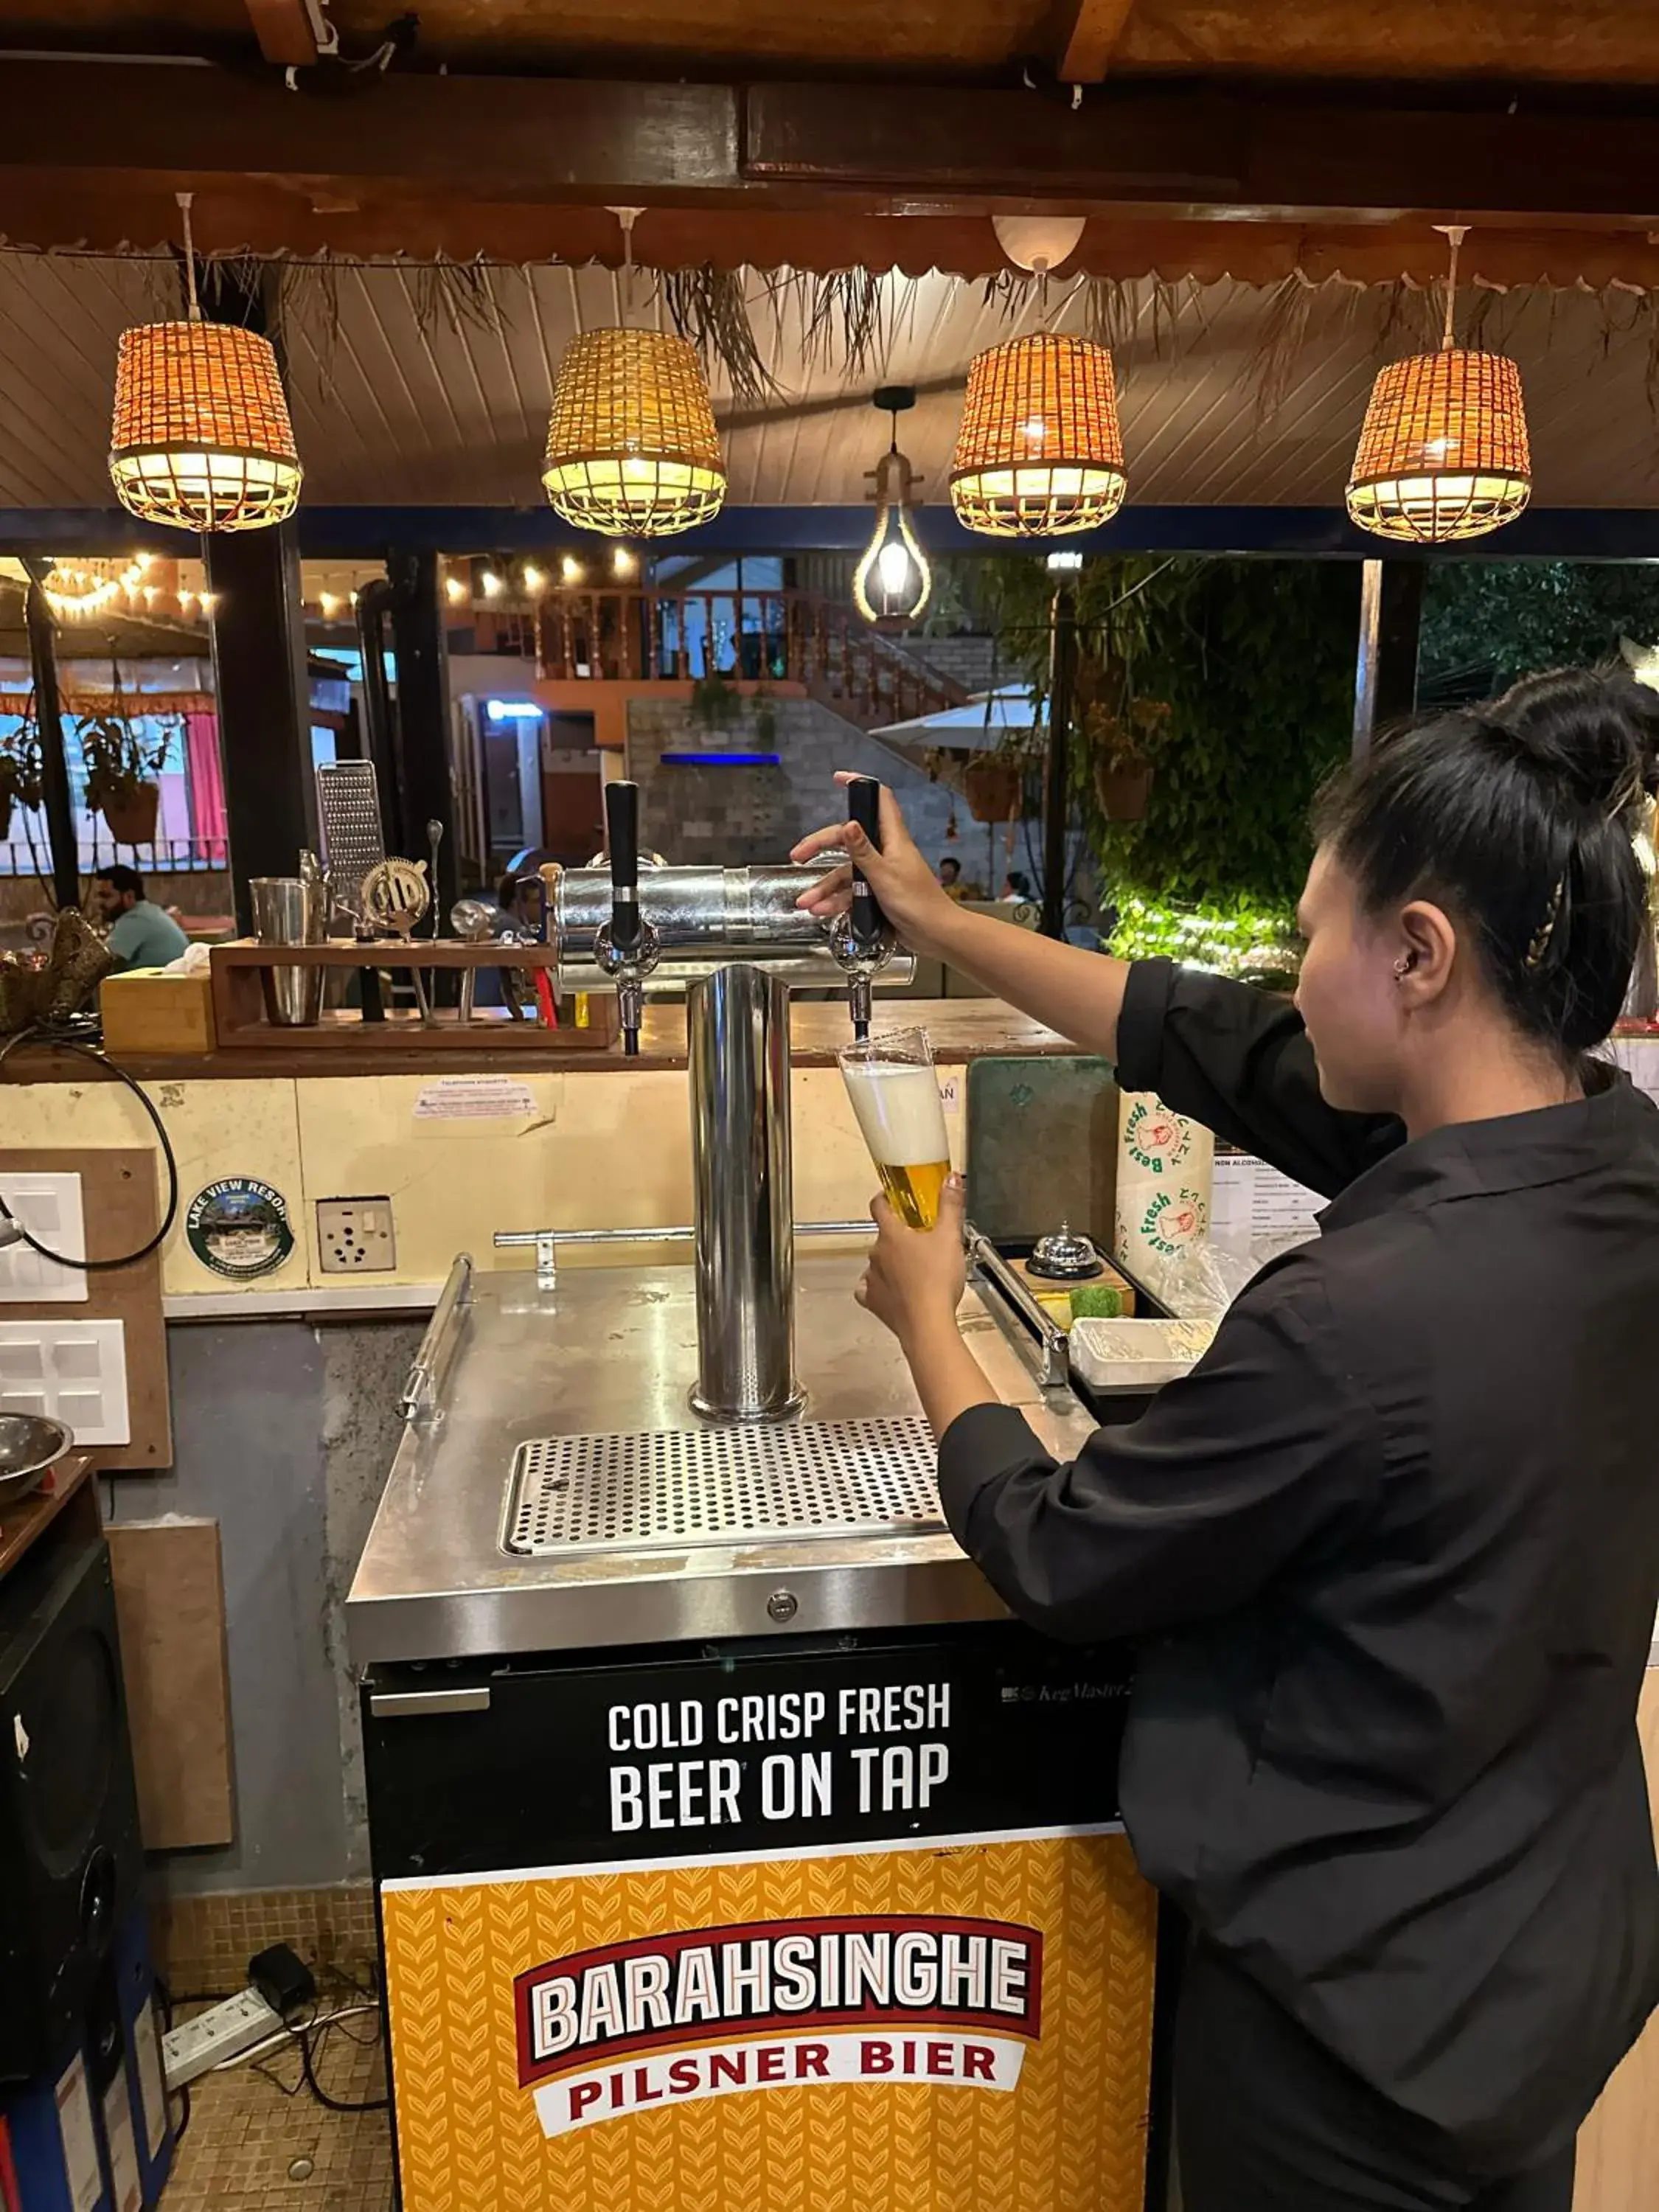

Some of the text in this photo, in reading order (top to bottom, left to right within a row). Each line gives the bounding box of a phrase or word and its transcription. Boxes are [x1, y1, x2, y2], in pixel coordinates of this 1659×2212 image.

[1124, 1102, 1163, 1173] Best Fresh
[1232, 1158, 1267, 1166] ALCOHOL
[188, 1196, 209, 1229] LAKE
[206, 1180, 243, 1197] VIEW
[1140, 1192, 1172, 1234] Fresh
[608, 1683, 950, 1751] COLD CRISP FRESH
[610, 1743, 949, 1832] BEER ON TAP
[531, 1931, 1027, 2060] BARAHSINGHE
[569, 2040, 995, 2120] PILSNER BIER
